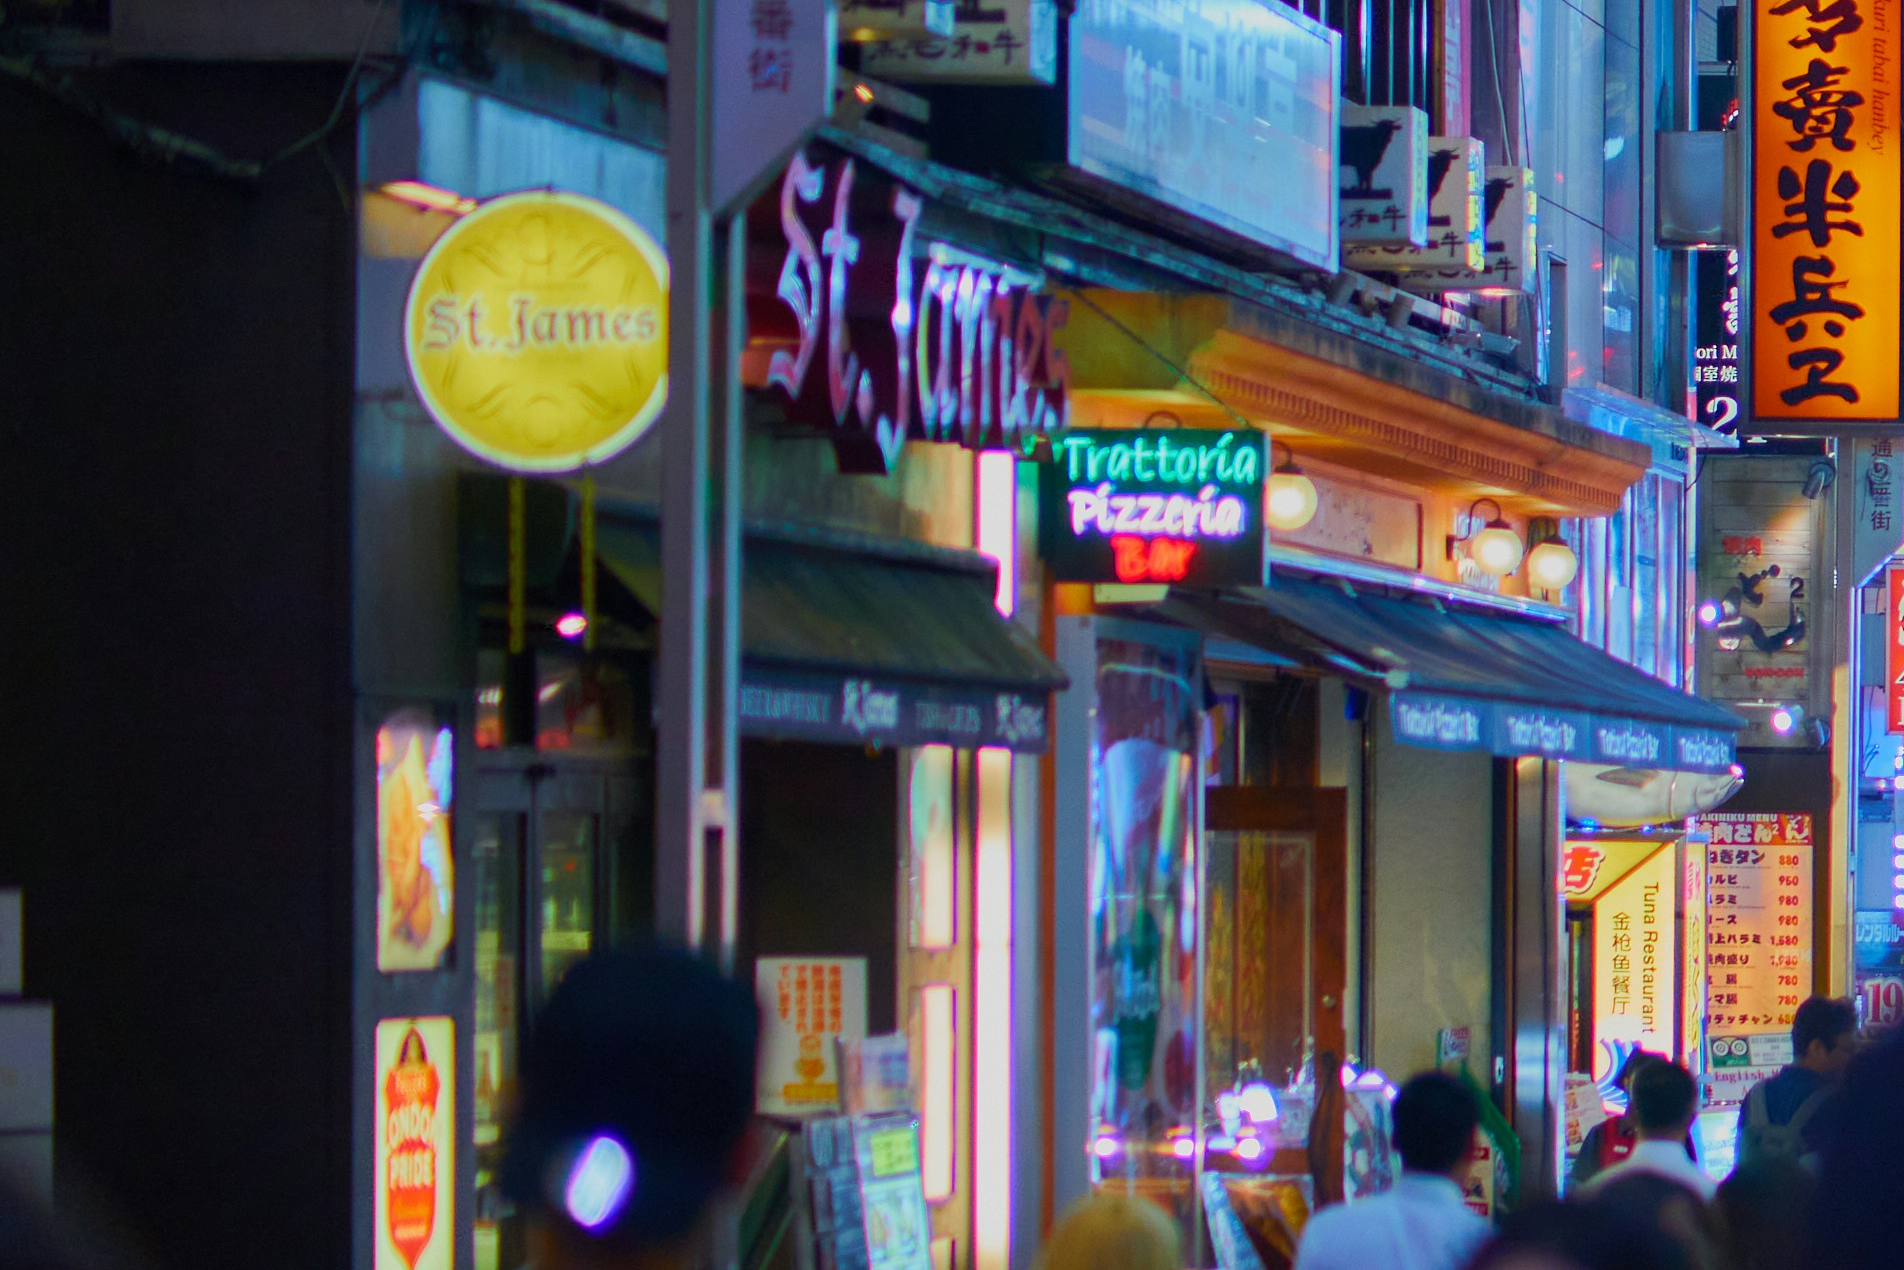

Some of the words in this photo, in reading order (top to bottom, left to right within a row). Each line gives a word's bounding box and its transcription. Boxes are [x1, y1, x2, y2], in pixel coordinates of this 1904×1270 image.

[505, 299, 657, 350] James
[1069, 486, 1245, 534] Pizzeria
[1643, 882, 1659, 924] Tuna
[1610, 911, 1632, 1015] 金枪鱼餐厅
[1640, 930, 1659, 1034] Restaurant
